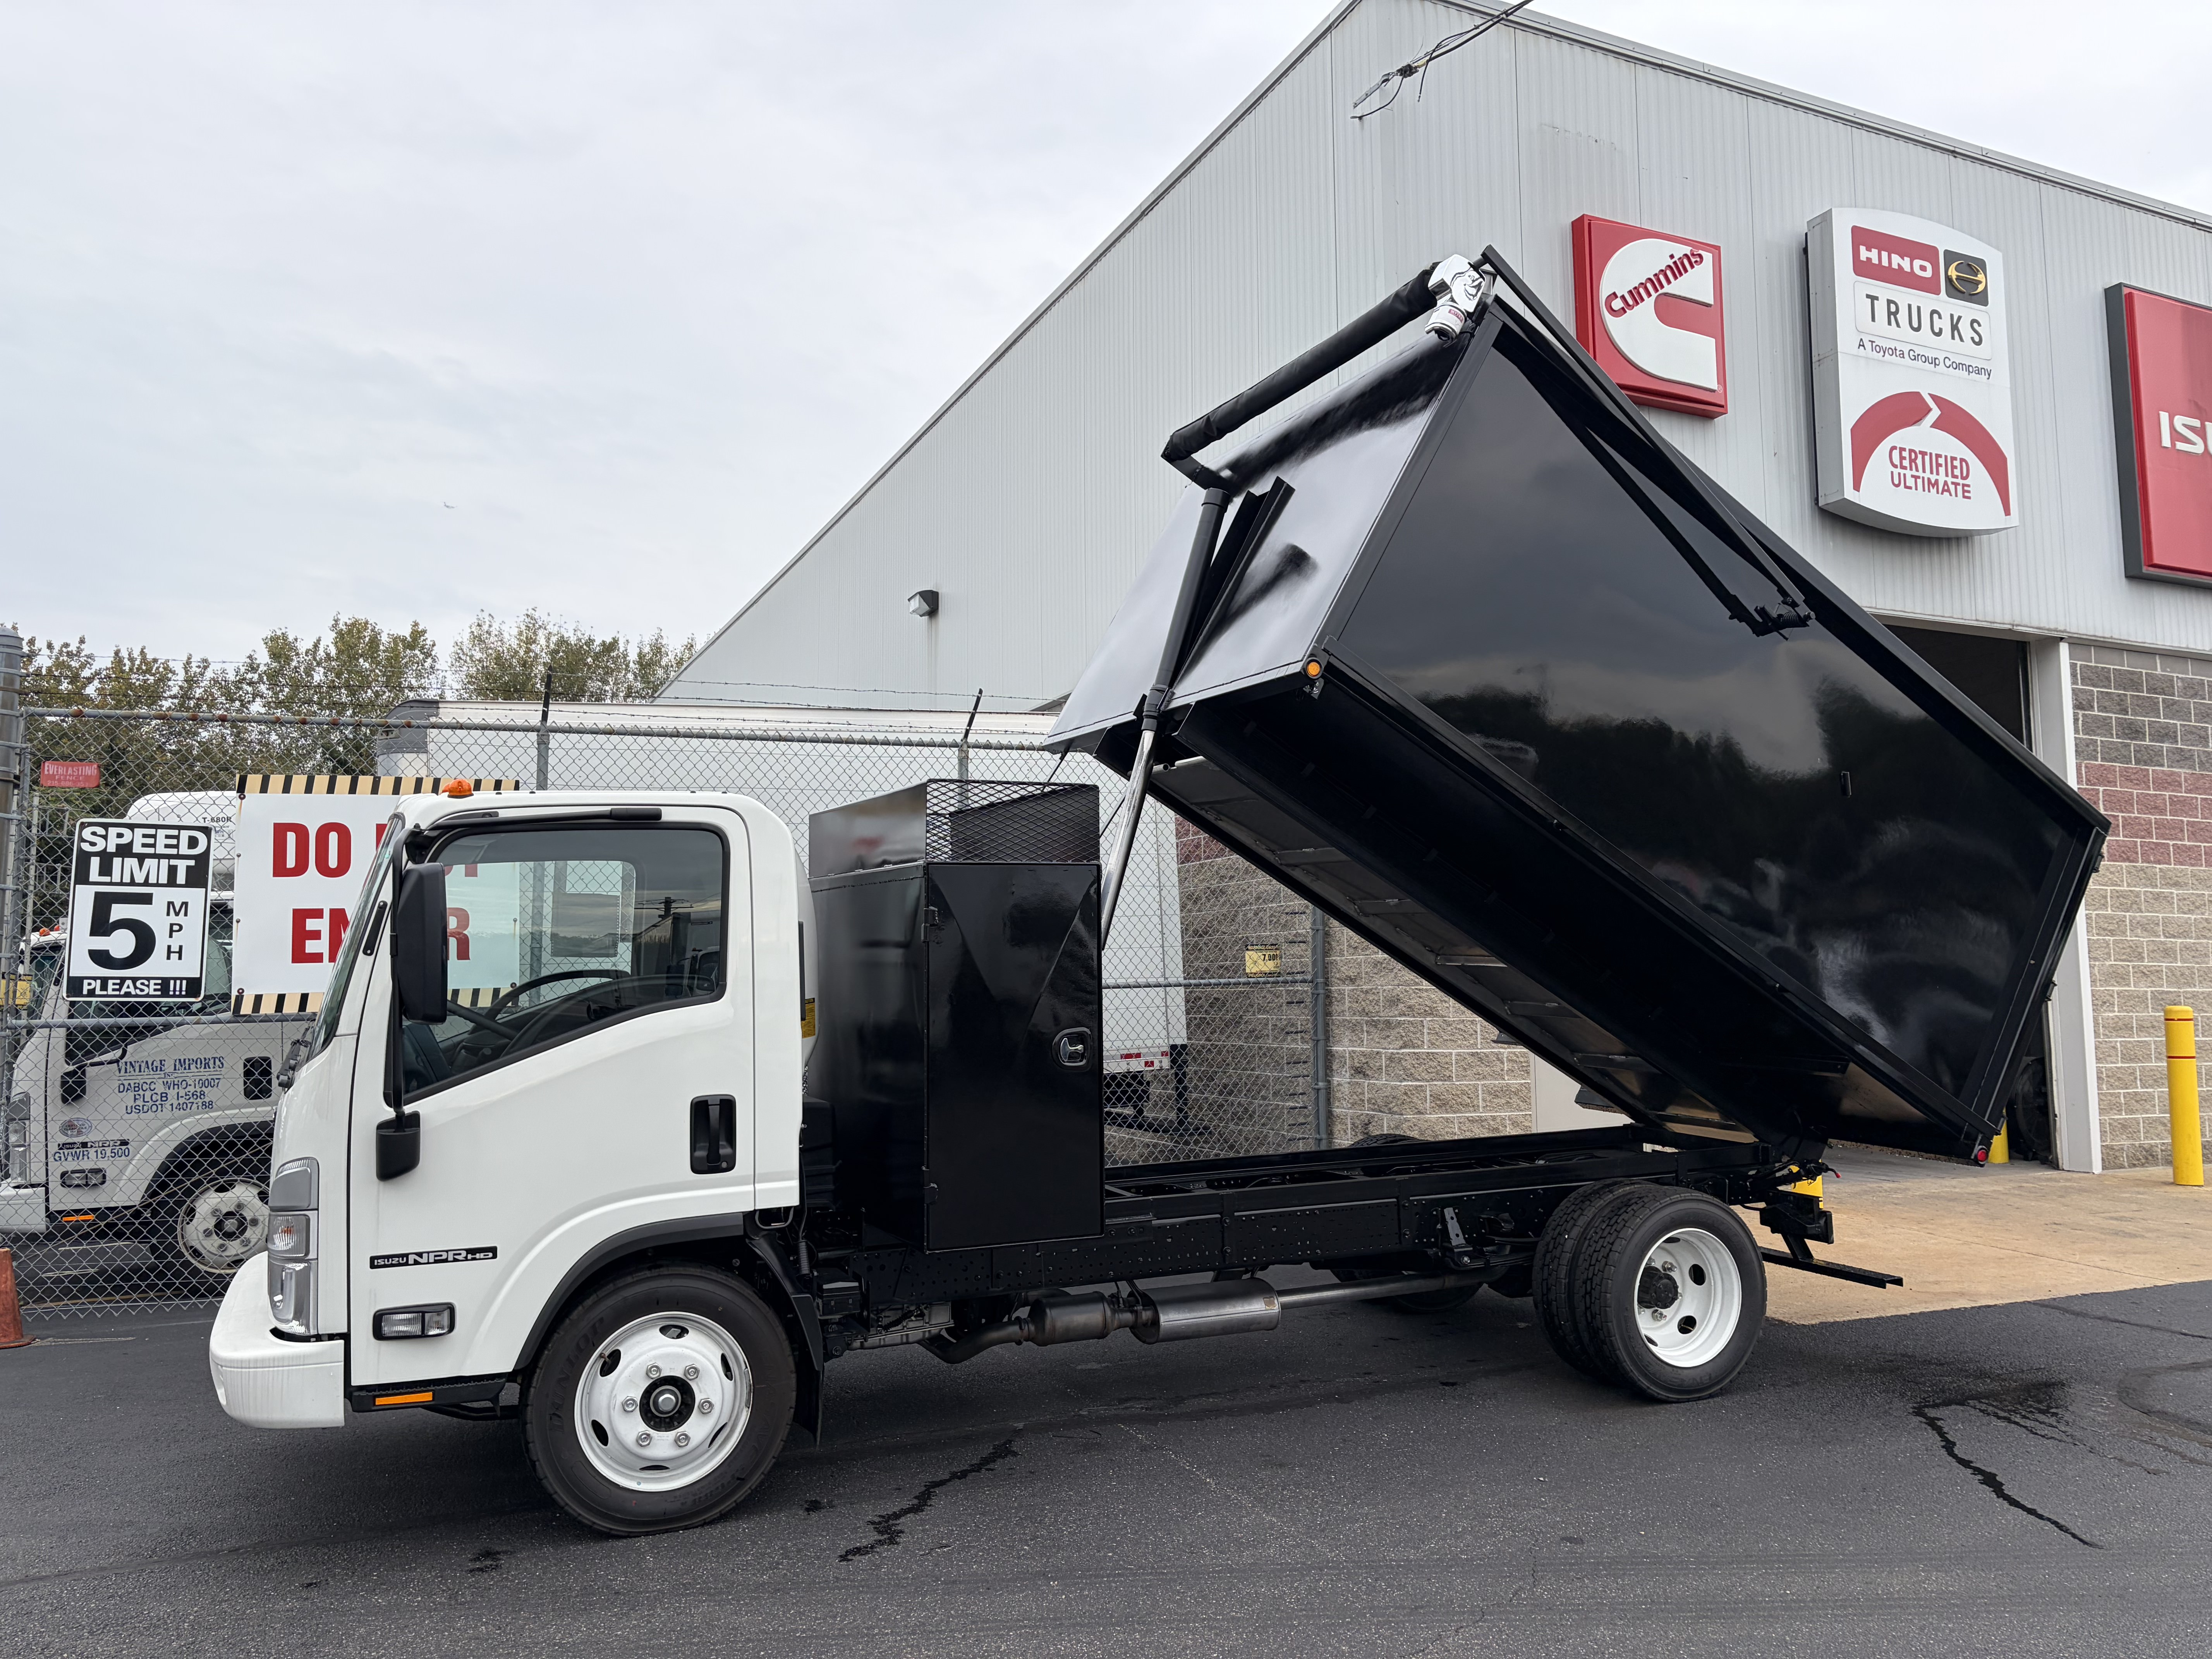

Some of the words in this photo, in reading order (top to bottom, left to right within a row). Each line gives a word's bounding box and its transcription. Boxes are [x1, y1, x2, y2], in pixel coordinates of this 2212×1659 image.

[1859, 245, 1932, 278] HINO
[1604, 248, 1704, 318] Cummins
[1865, 294, 1983, 346] TRUCKS
[1858, 338, 1866, 350] A
[1869, 340, 1905, 359] Toyota
[1908, 349, 1940, 368] Group
[1943, 356, 1992, 380] Company
[2159, 411, 2212, 456] IS
[1889, 445, 1970, 481] CERTIFIED
[1891, 471, 1972, 500] ULTIMATE
[45, 763, 97, 776] EVERLASTING
[81, 826, 208, 855] SPEED
[273, 822, 351, 878] DO
[89, 857, 195, 884] LIMIT
[88, 891, 156, 970] 5
[82, 979, 161, 994] PLEASE
[169, 980, 187, 995] !!!
[117, 1059, 166, 1074] VINTAGE
[173, 1056, 224, 1071] IMPORTS
[118, 1081, 156, 1093] DABCC
[162, 1078, 221, 1091] WHO-10007
[134, 1092, 168, 1103] PLCB
[177, 1090, 206, 1101] I-568
[125, 1103, 164, 1115] USDOT
[169, 1100, 213, 1112] 1407188
[53, 1150, 89, 1162] GVWR
[374, 1257, 406, 1266] ISUZU
